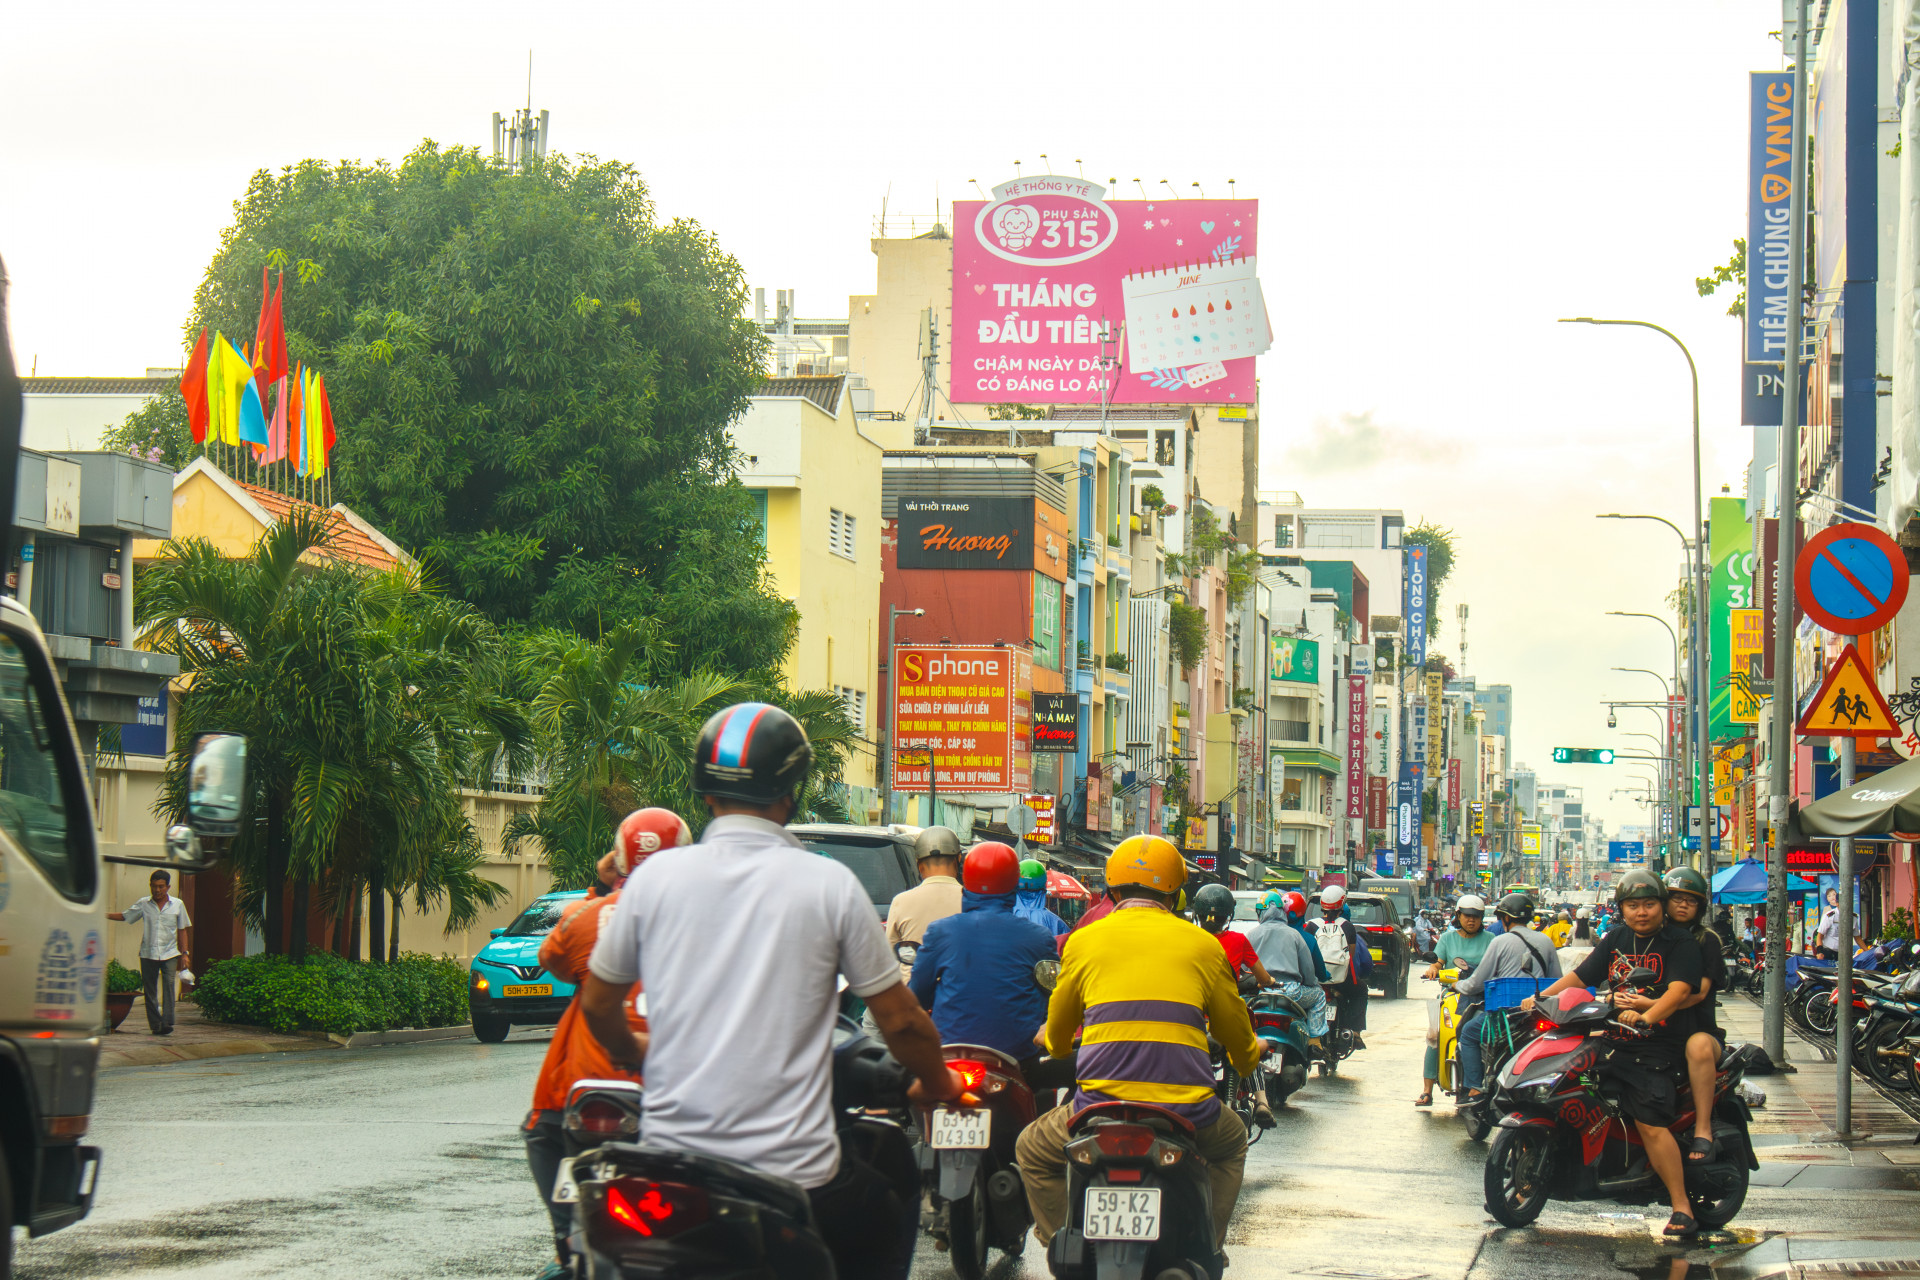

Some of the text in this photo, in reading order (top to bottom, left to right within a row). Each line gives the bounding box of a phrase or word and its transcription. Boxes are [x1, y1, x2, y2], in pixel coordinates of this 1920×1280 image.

[1766, 81, 1793, 168] VNVC
[1005, 179, 1091, 196] HỆ THỐNG Y TẾ
[1043, 207, 1098, 221] PHỤ SẢN
[1041, 220, 1098, 248] 315
[1177, 274, 1202, 289] JUNE
[1758, 207, 1790, 353] TIÊM CHỦNG
[993, 278, 1097, 308] THÁNG
[978, 311, 1110, 344] ĐẦU TIÊN
[974, 355, 1022, 374] CHẬM
[1028, 355, 1074, 371] NGÀY
[976, 375, 1110, 391] CÓ ĐÁNG LO ÂU
[1757, 374, 1785, 396] PN
[905, 500, 970, 511] VẢI THỜI TRANG
[919, 524, 1013, 560] Hương
[1411, 561, 1423, 665] LONG CHÂU
[903, 653, 999, 683] S phone
[899, 684, 1005, 699] MUA BÁN ĐIỆN THOẠI CŨ GIÁ CAO
[899, 699, 912, 714] SỬA
[933, 701, 942, 714] ÉP
[943, 701, 959, 714] KÍNH
[961, 721, 972, 732] PIN
[1056, 713, 1075, 723] MAY
[1034, 724, 1076, 744] Hương
[947, 736, 961, 749] CÁP
[962, 738, 976, 751] SẠC
[1351, 693, 1362, 815] HƯNG PHÁT USA
[1555, 748, 1566, 760] 21
[898, 771, 911, 782] BAO
[912, 771, 921, 782] DA
[953, 772, 966, 783] PIN
[967, 771, 978, 785] DỰ
[977, 769, 1001, 783] PHÒNG
[1401, 805, 1409, 842] Pharmacity
[1786, 850, 1832, 864] attana
[507, 986, 549, 995] 50H-375.79
[936, 1129, 986, 1146] 043.91
[1097, 1192, 1149, 1214] 59-K2
[1089, 1215, 1155, 1237] 514.87
